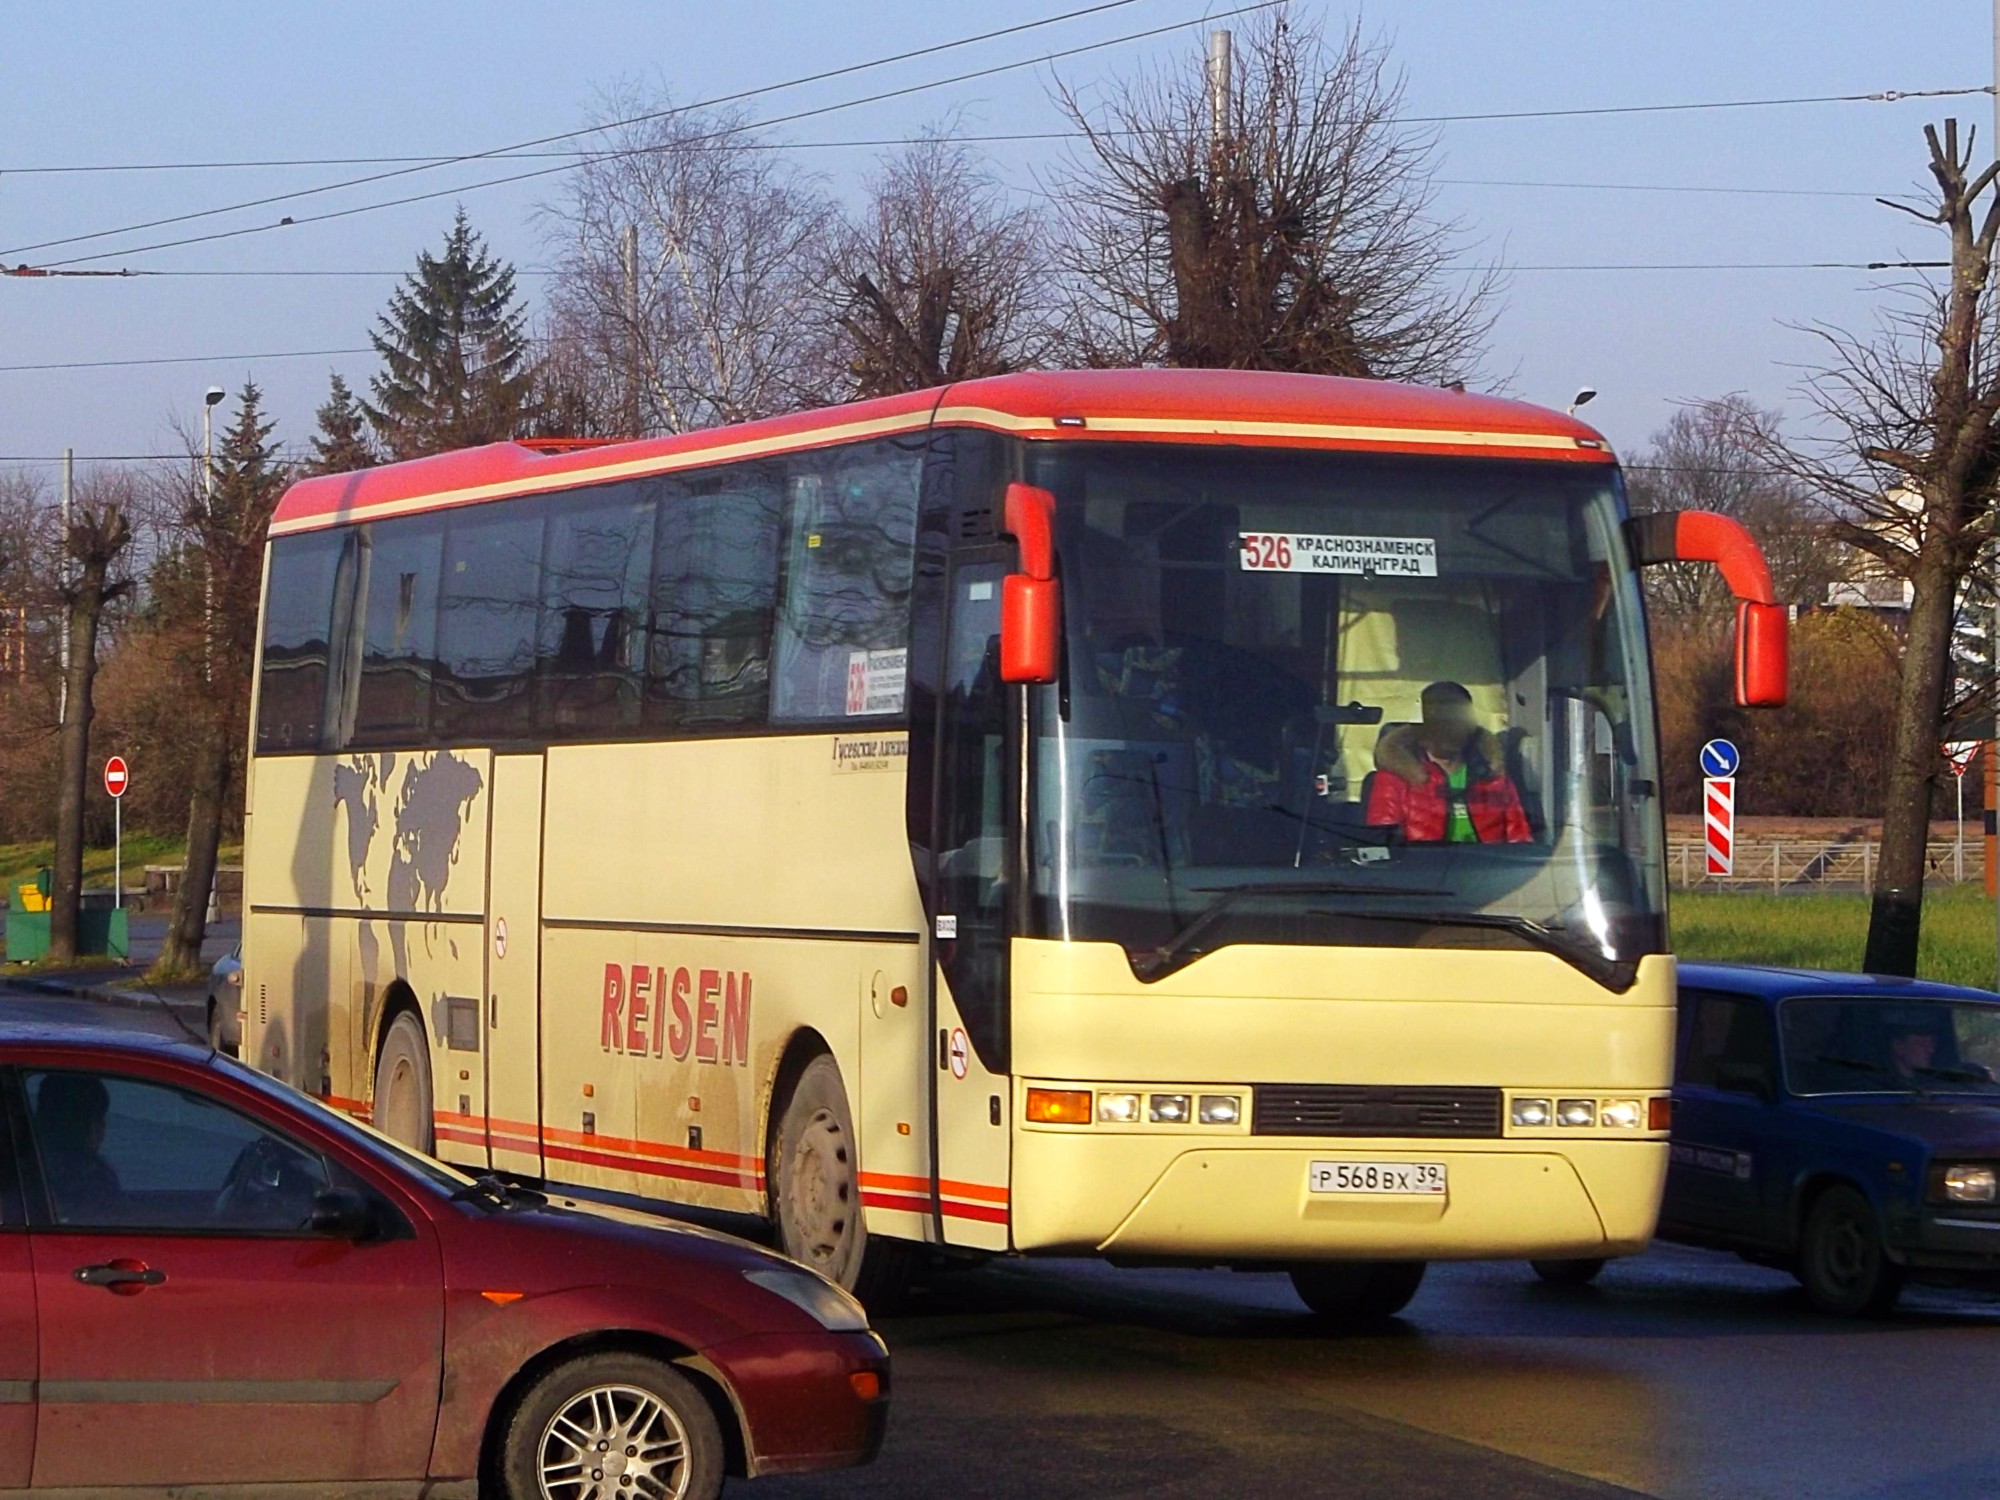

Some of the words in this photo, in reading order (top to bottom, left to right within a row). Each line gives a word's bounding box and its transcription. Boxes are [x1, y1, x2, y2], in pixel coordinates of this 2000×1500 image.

[1246, 535, 1292, 569] 526
[1297, 537, 1434, 556] КРАСНОЗНАМЕНСК
[1312, 555, 1421, 574] КАЛИНИНГРАД
[600, 962, 752, 1067] REISEN
